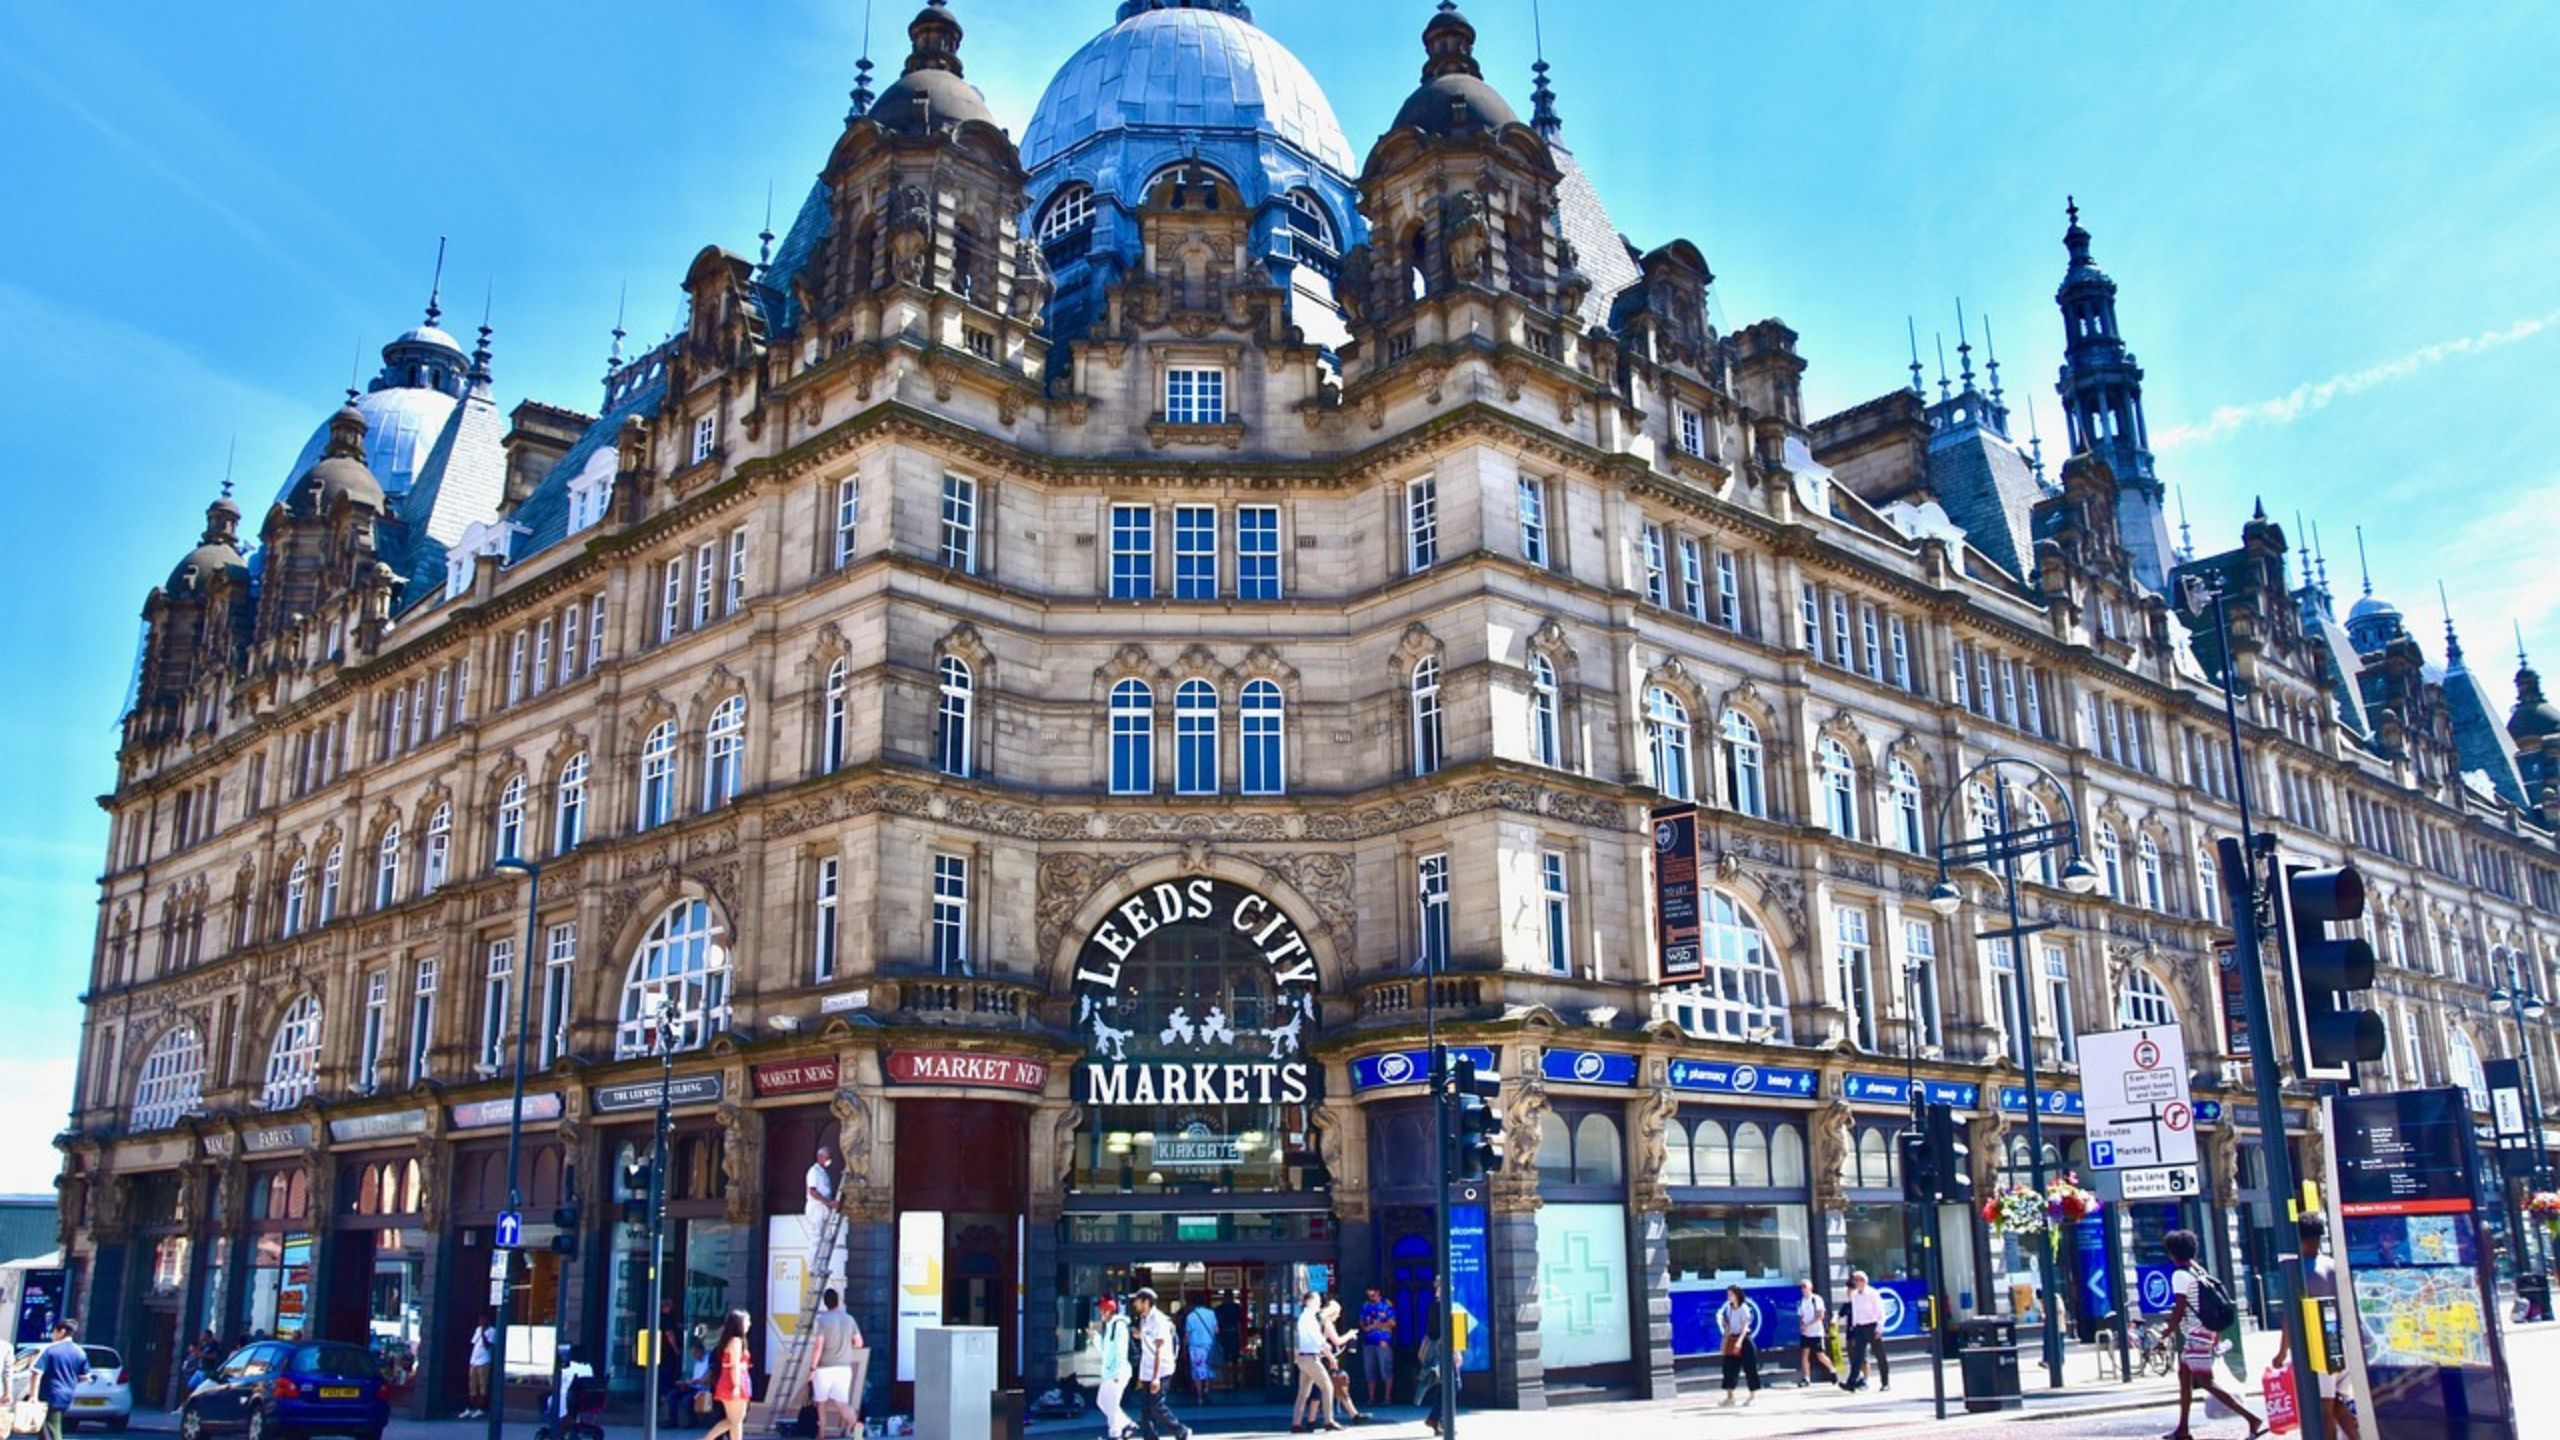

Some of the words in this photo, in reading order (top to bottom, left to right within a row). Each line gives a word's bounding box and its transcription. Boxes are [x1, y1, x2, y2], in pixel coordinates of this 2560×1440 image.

[1077, 880, 1213, 988] LEEDS
[1232, 894, 1317, 986] CITY
[759, 1069, 801, 1088] MARKET
[804, 1064, 834, 1082] NEWS
[913, 1056, 1010, 1081] MARKET
[1688, 1068, 1727, 1084] pharmacy
[1767, 1074, 1792, 1088] beauty
[1088, 1063, 1307, 1105] MARKETS
[1866, 1082, 1898, 1096] pharmacy
[1937, 1088, 1957, 1101] beauty
[613, 1091, 628, 1101] THE
[478, 1102, 533, 1123] Fantaia
[2090, 1129, 2102, 1137] All
[2103, 1127, 2132, 1137] routes
[1160, 1142, 1237, 1158] KIRKGATE
[2095, 1143, 2111, 1164] P
[2116, 1147, 2152, 1156] Markets
[2125, 1173, 2142, 1182] Bus
[2144, 1171, 2165, 1181] lane
[2126, 1184, 2166, 1193] cameras
[1450, 1226, 1483, 1235] elcome
[2266, 1394, 2293, 1416] SALE
